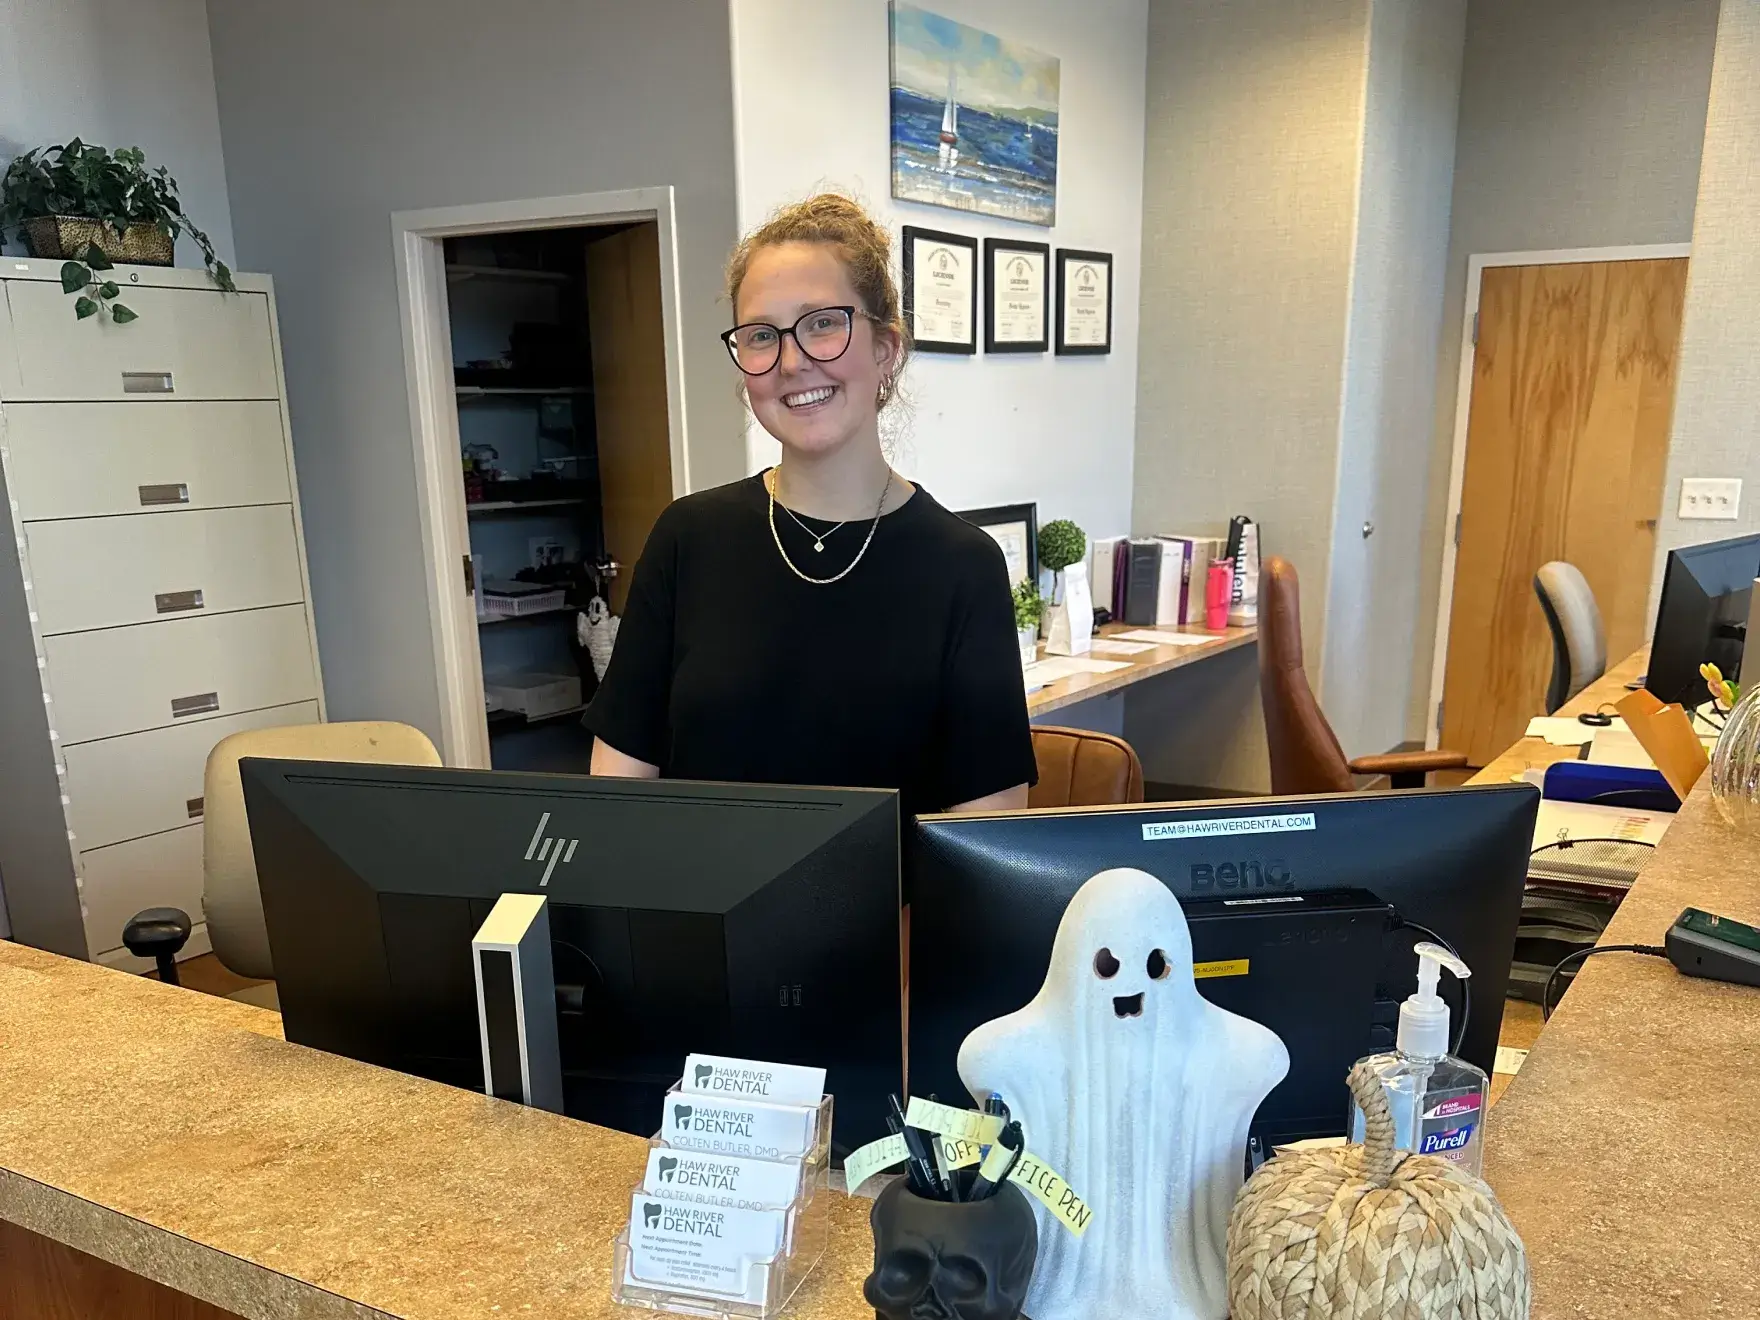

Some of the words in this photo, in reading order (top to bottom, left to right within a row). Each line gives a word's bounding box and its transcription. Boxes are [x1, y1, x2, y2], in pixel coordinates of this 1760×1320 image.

[1147, 816, 1312, 836] TEAM@HAWRIVERDENTAL.COM
[714, 1067, 741, 1079] HAW
[742, 1070, 773, 1083] RIVER
[713, 1077, 770, 1095] DENTAL
[694, 1107, 721, 1120] HAW
[723, 1111, 754, 1124] RIVER
[694, 1118, 753, 1138] DENTAL
[672, 1135, 711, 1149] COLTEN
[755, 1145, 779, 1157] DMD
[1425, 1130, 1468, 1152] Purell
[679, 1159, 707, 1172] HAW
[708, 1163, 740, 1177] RIVER
[678, 1170, 737, 1191] DENTAL
[655, 1187, 693, 1203] COLTEN
[738, 1199, 763, 1212] DMD
[1014, 1160, 1058, 1198] FICE
[1058, 1187, 1092, 1229] PEN
[664, 1205, 691, 1219] HAW
[693, 1209, 725, 1224] RIVER
[663, 1216, 723, 1238] DENTAL
